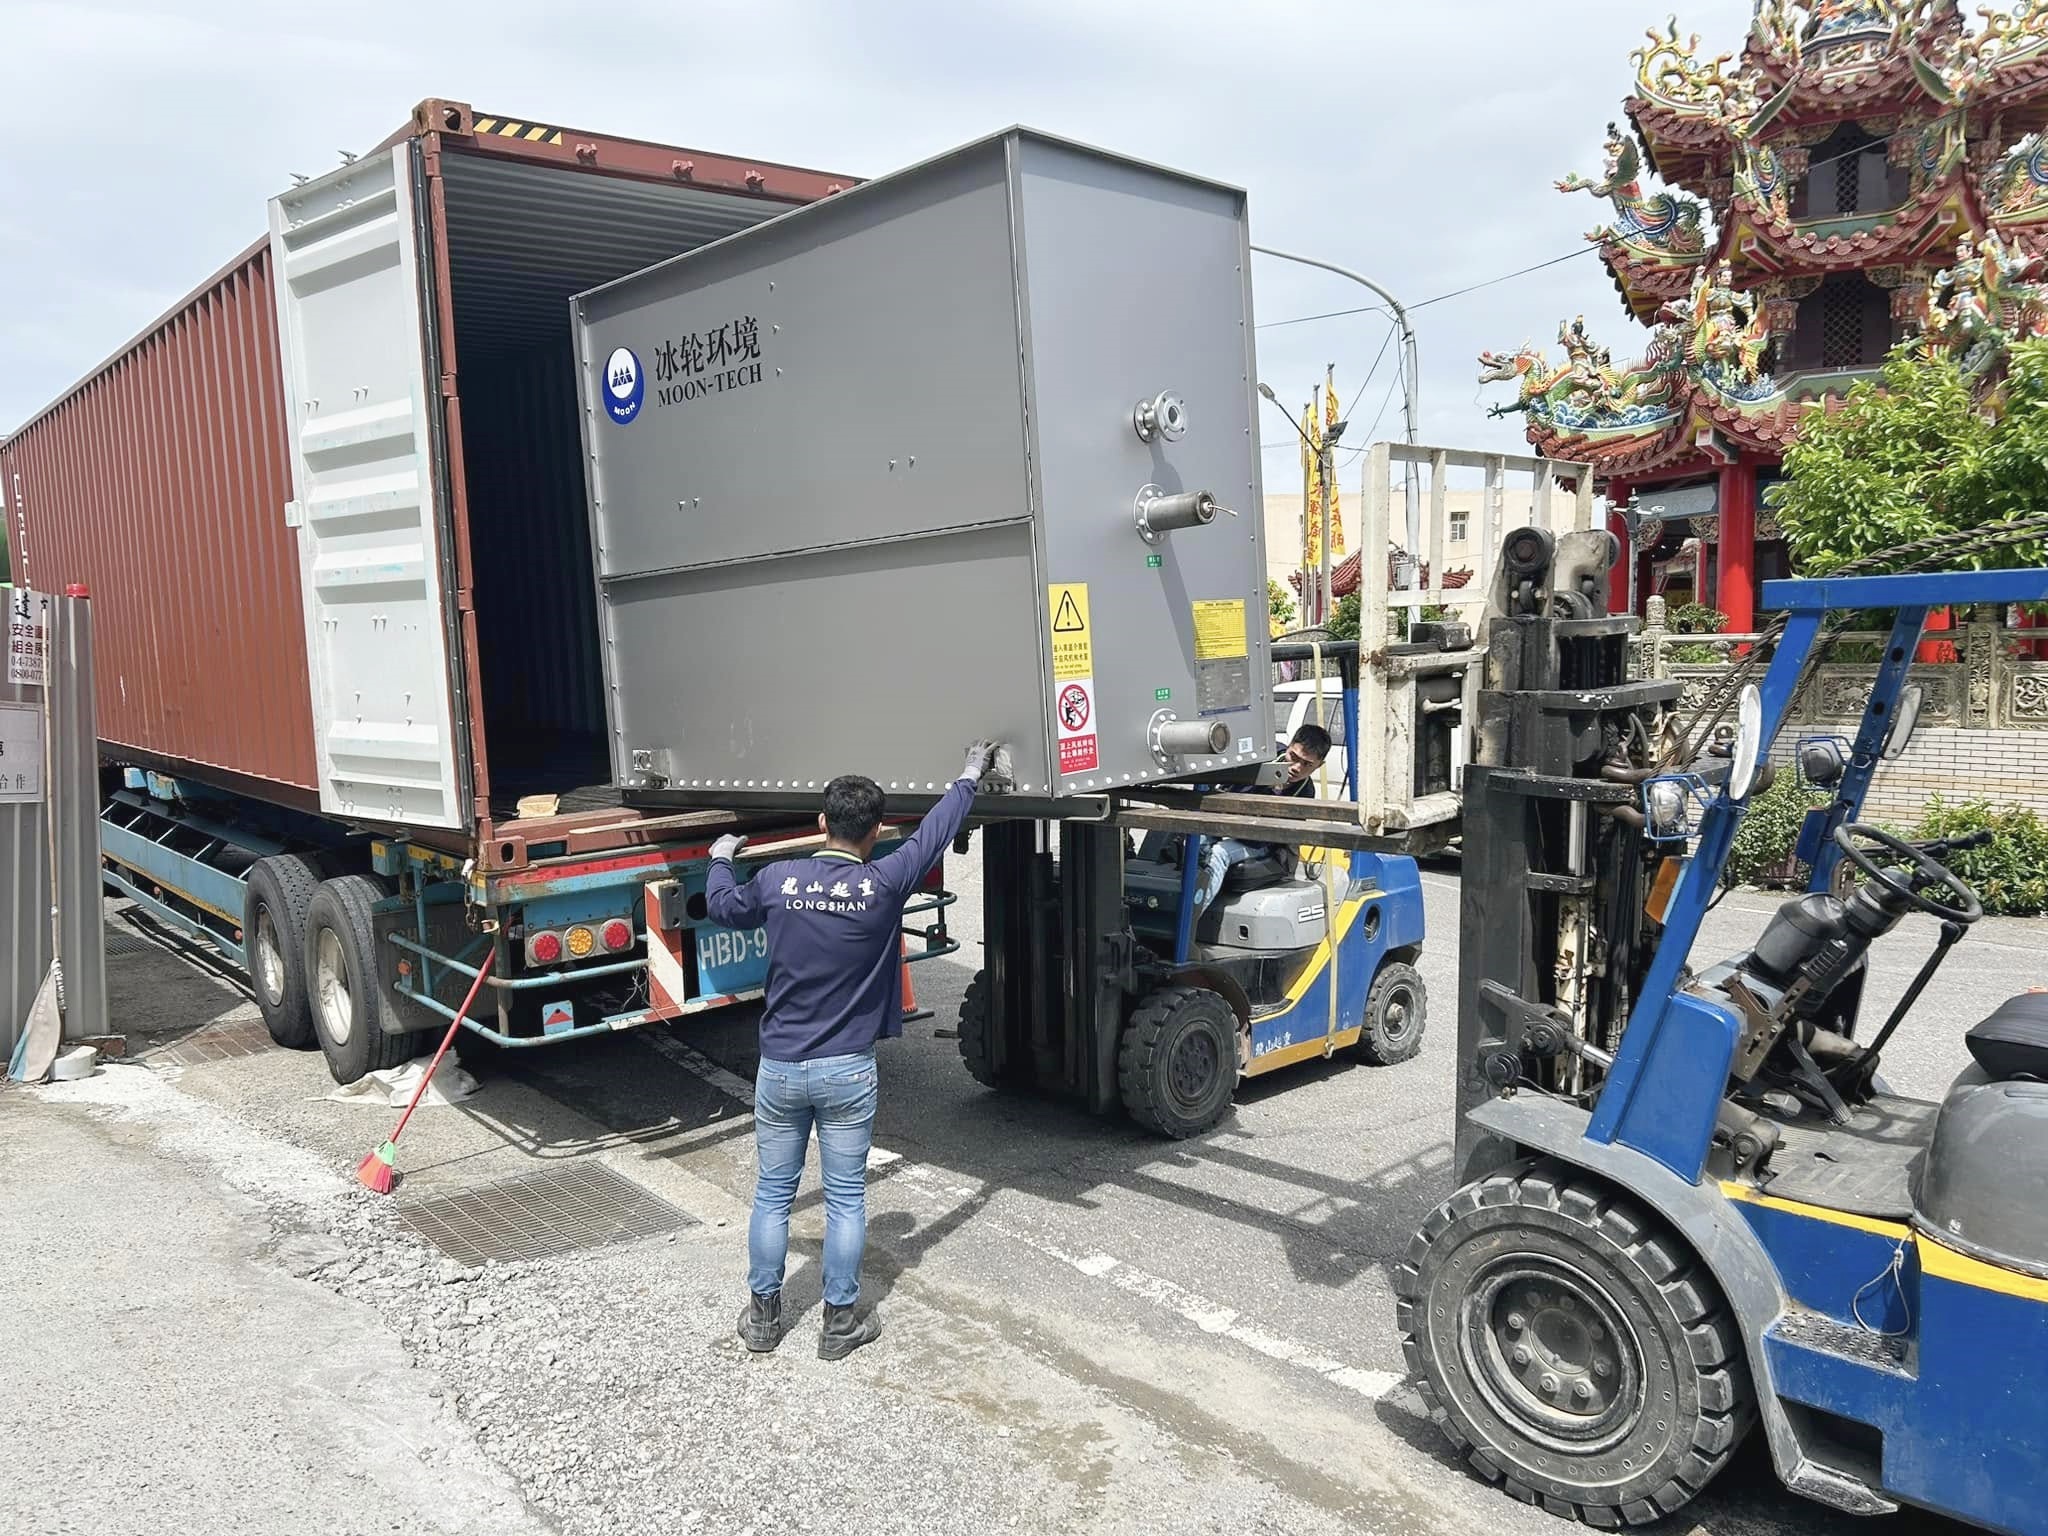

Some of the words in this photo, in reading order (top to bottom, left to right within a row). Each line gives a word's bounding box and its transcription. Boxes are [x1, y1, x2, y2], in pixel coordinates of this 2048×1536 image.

[654, 315, 761, 382] 冰轮环境
[657, 362, 762, 408] MOON-TECH
[614, 401, 636, 416] MOON
[786, 899, 866, 912] LONGSHAN
[1298, 903, 1325, 922] 25
